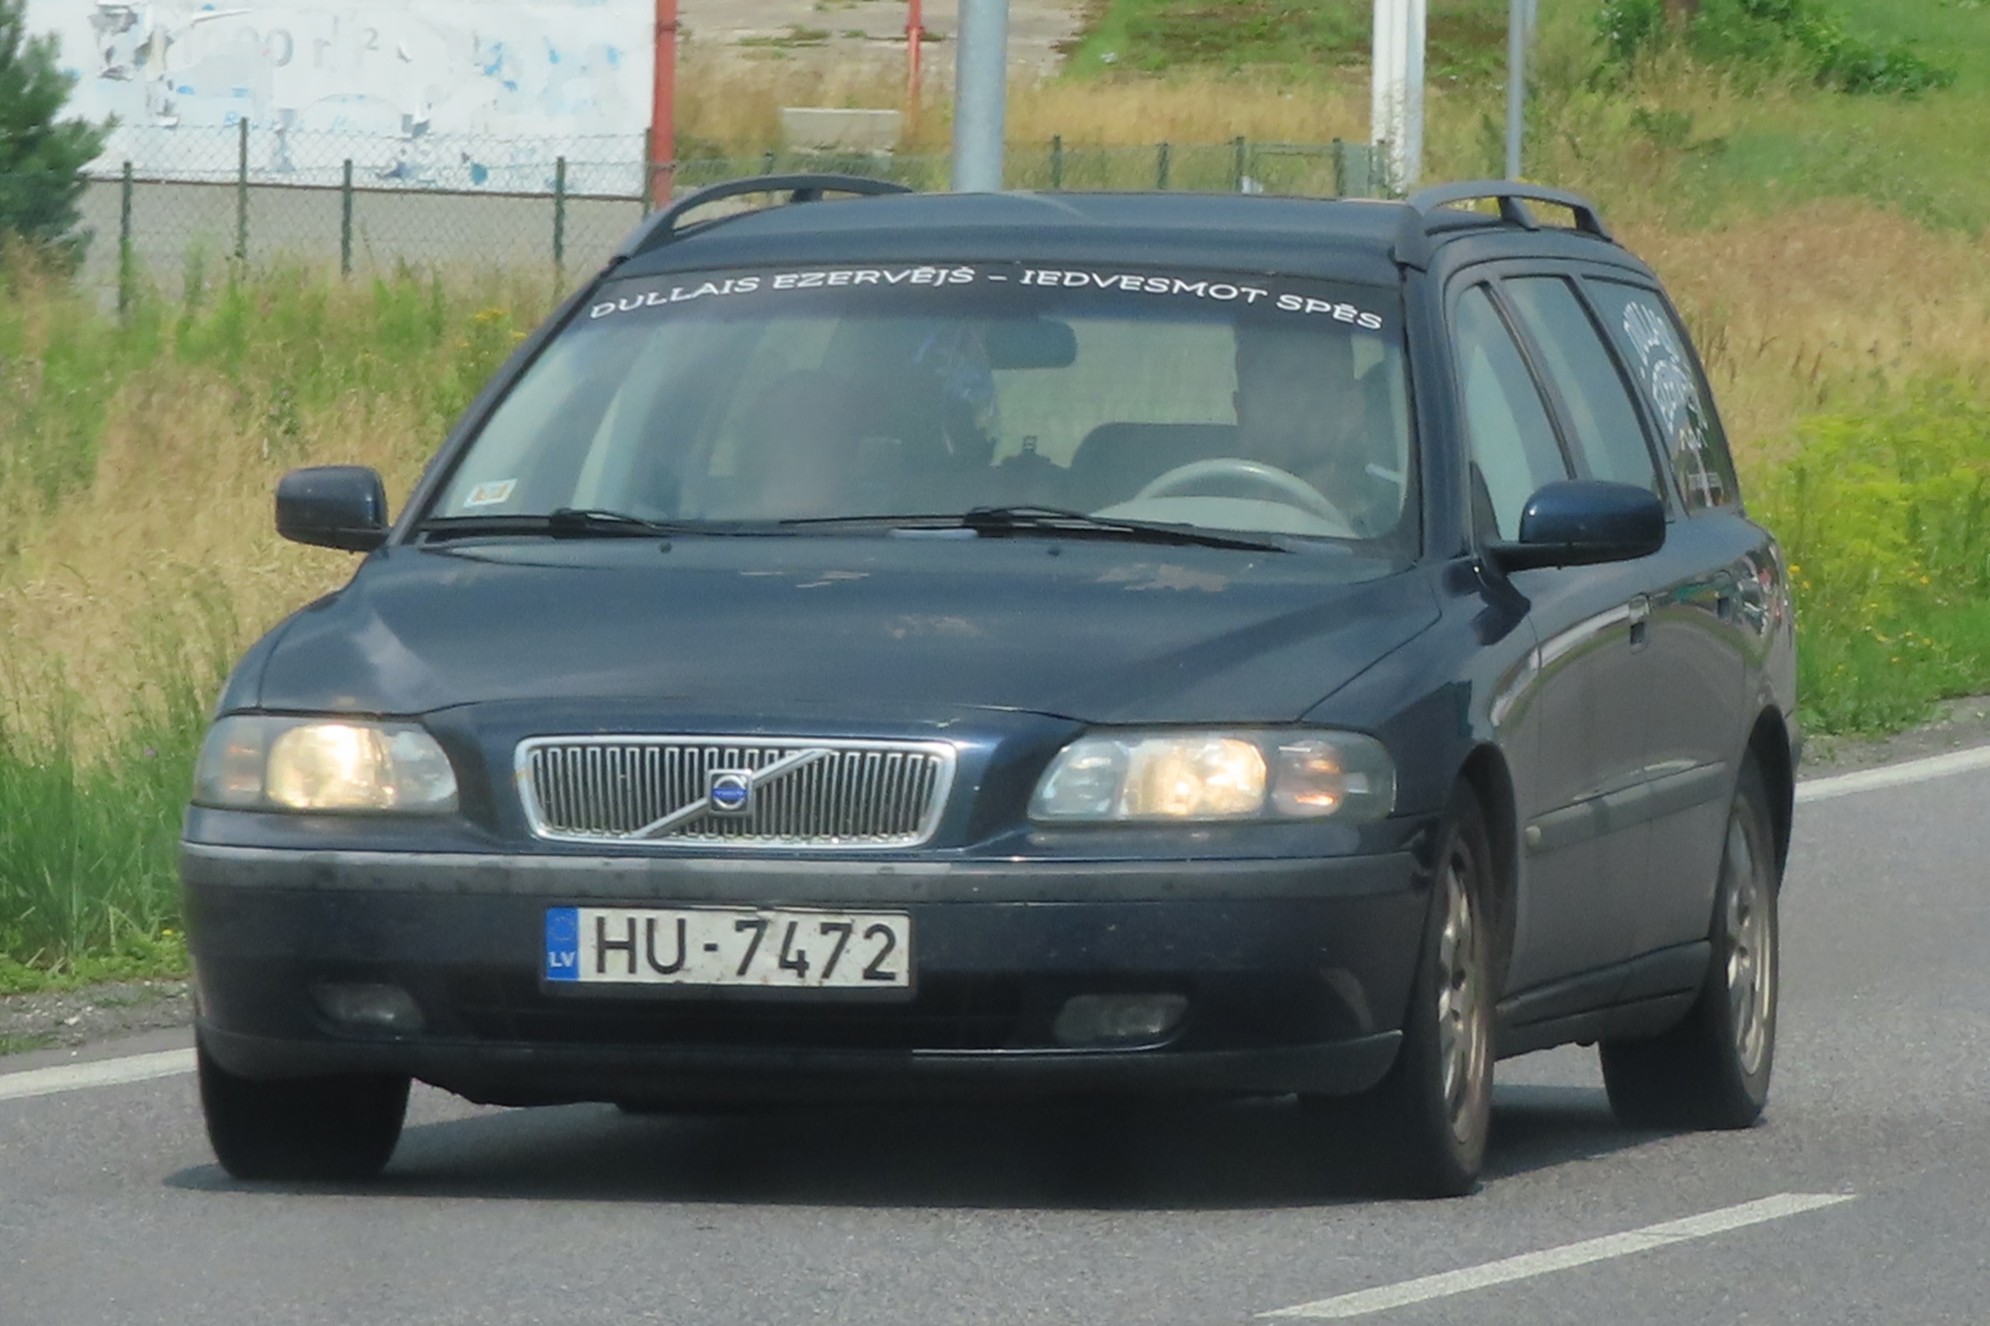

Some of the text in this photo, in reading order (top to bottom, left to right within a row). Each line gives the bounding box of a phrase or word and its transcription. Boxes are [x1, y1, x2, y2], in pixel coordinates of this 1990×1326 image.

[589, 276, 760, 319] DULLAIS
[1019, 269, 1268, 304] IEDVESMOT
[549, 951, 575, 968] LV
[596, 915, 897, 981] HU-7472
